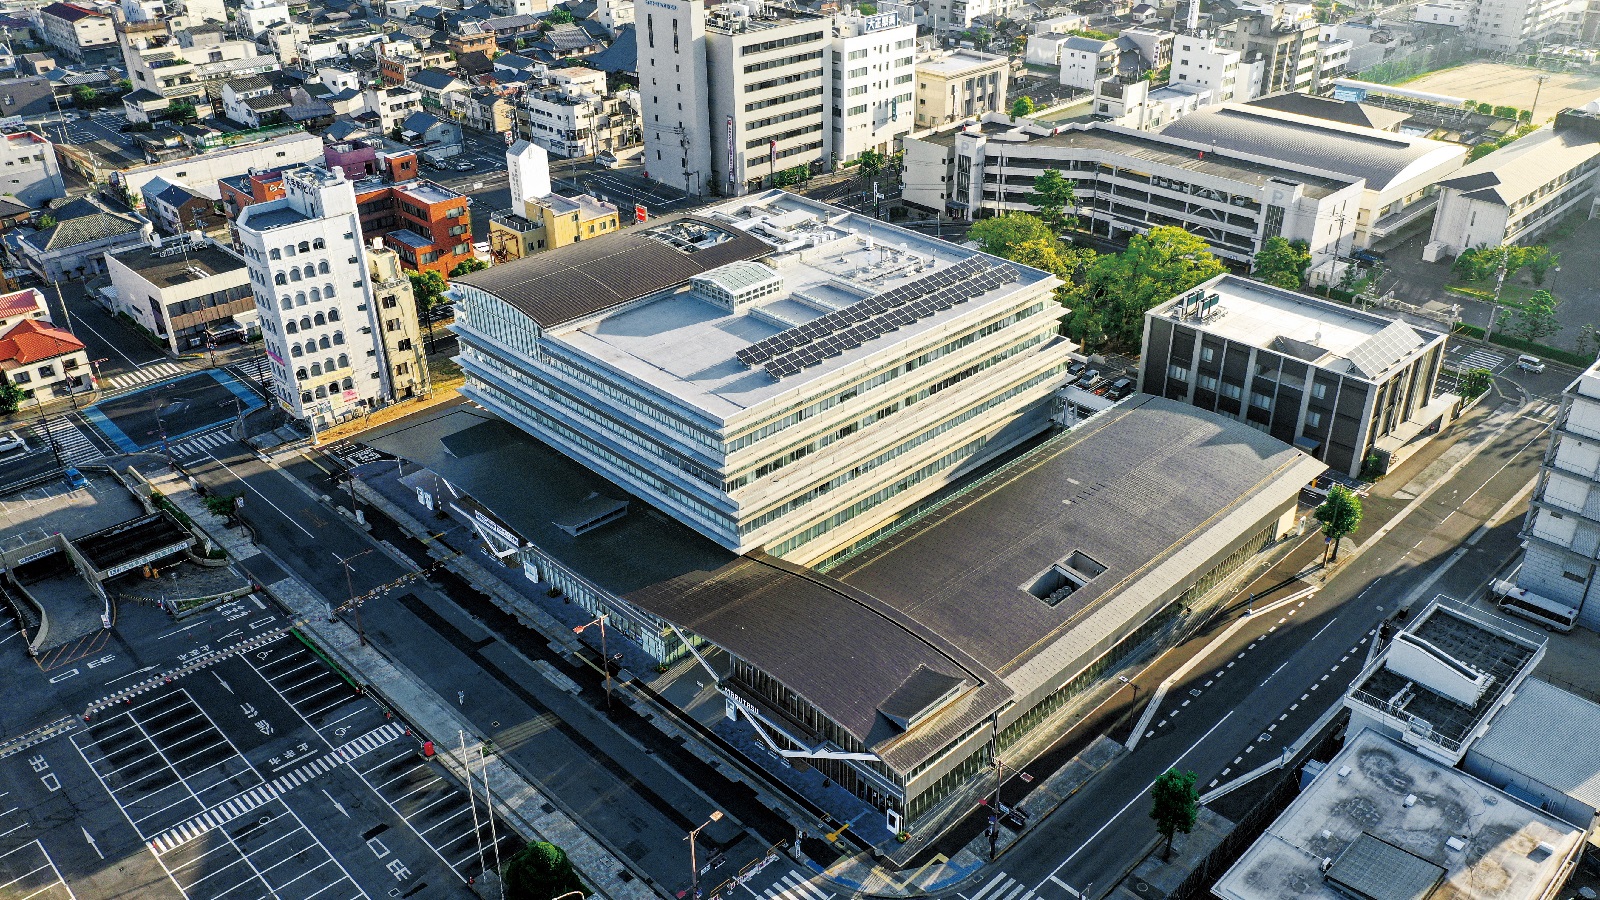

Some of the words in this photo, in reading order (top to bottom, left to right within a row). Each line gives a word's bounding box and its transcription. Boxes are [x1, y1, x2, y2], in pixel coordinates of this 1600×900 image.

[1272, 189, 1285, 203] P
[724, 687, 759, 714] MARUTASU
[268, 742, 309, 765] 止まれ
[28, 754, 62, 792] 出口
[366, 836, 412, 882] 出口
